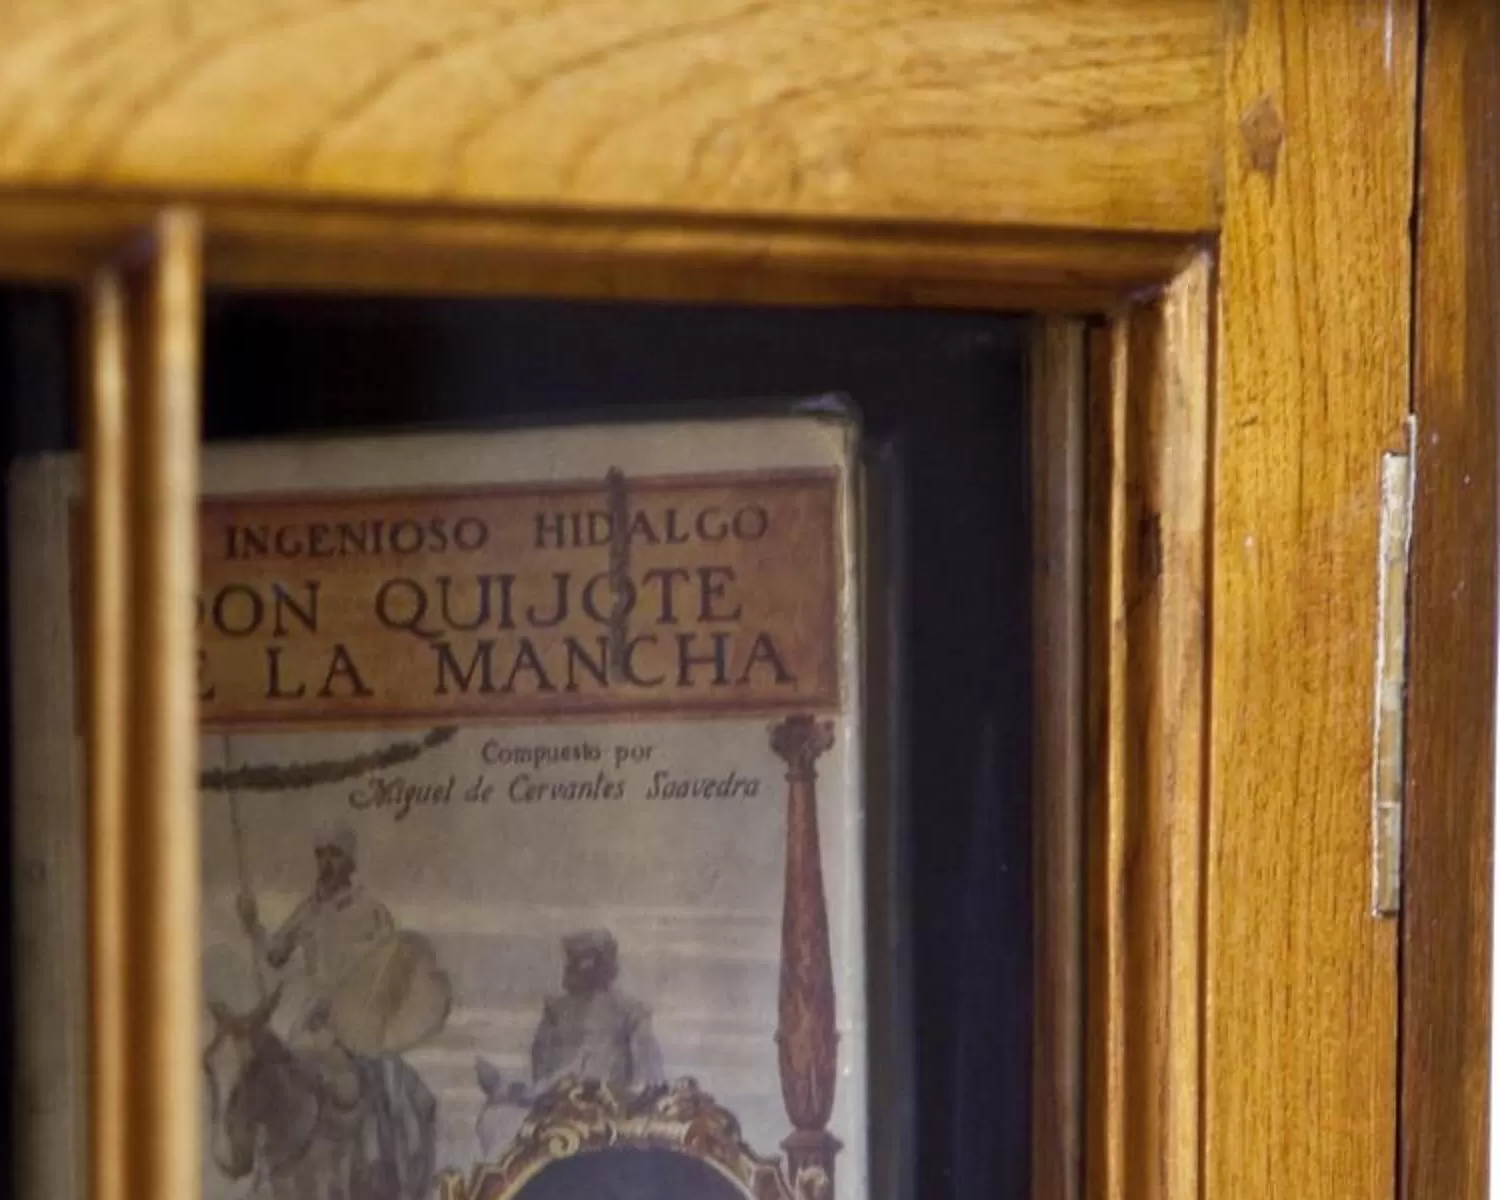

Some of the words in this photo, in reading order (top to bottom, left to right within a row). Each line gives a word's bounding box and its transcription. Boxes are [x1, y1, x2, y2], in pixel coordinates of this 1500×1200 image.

[225, 516, 488, 560] INGENIOSO
[534, 505, 769, 548] HIDALGO
[196, 578, 320, 638] ON
[375, 565, 742, 638] QUIJOTE
[264, 643, 375, 698] LA
[430, 631, 796, 695] MANCHA
[481, 738, 602, 768] Compuesto
[614, 744, 653, 769] por
[348, 774, 456, 822] Miguel
[464, 773, 496, 804] de
[508, 772, 626, 805] Cervantes
[645, 769, 761, 801] Saavedra
